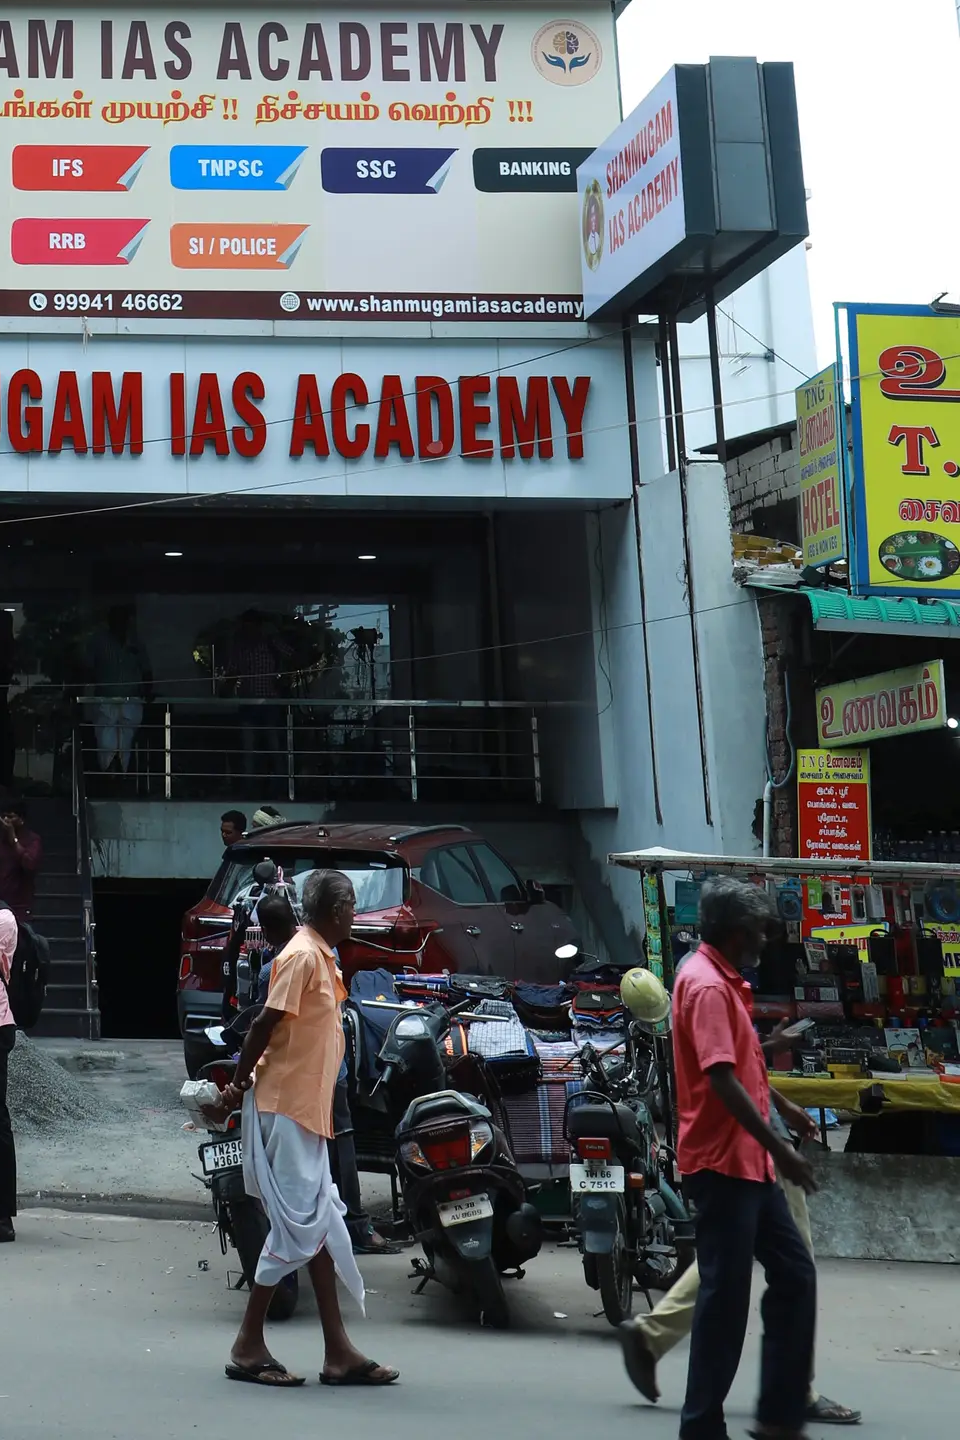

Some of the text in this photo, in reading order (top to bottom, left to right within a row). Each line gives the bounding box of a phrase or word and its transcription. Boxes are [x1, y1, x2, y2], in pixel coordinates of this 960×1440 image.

[100, 19, 193, 81] IAS
[216, 21, 506, 83] ACADEMY
[101, 90, 216, 127] முயற்சி
[254, 90, 380, 127] நிச்சயம்
[388, 91, 494, 129] வெற்றி
[52, 159, 84, 177] IFS
[198, 159, 265, 178] TNPSC
[356, 160, 397, 179] SSC
[499, 161, 572, 177] BANKING
[606, 100, 673, 200] SHANMUGAM
[608, 208, 626, 254] IAS
[628, 156, 679, 239] ACADEMY
[48, 232, 86, 250] RRB
[188, 238, 205, 256] SI
[220, 238, 277, 257] POLICE
[53, 293, 115, 311] 99941
[121, 294, 183, 312] 46662
[169, 371, 267, 457] IAS
[289, 372, 592, 460] ACADEMY
[804, 380, 825, 410] TNG
[802, 477, 840, 538] HOTEL
[820, 667, 939, 740] உணவகம்
